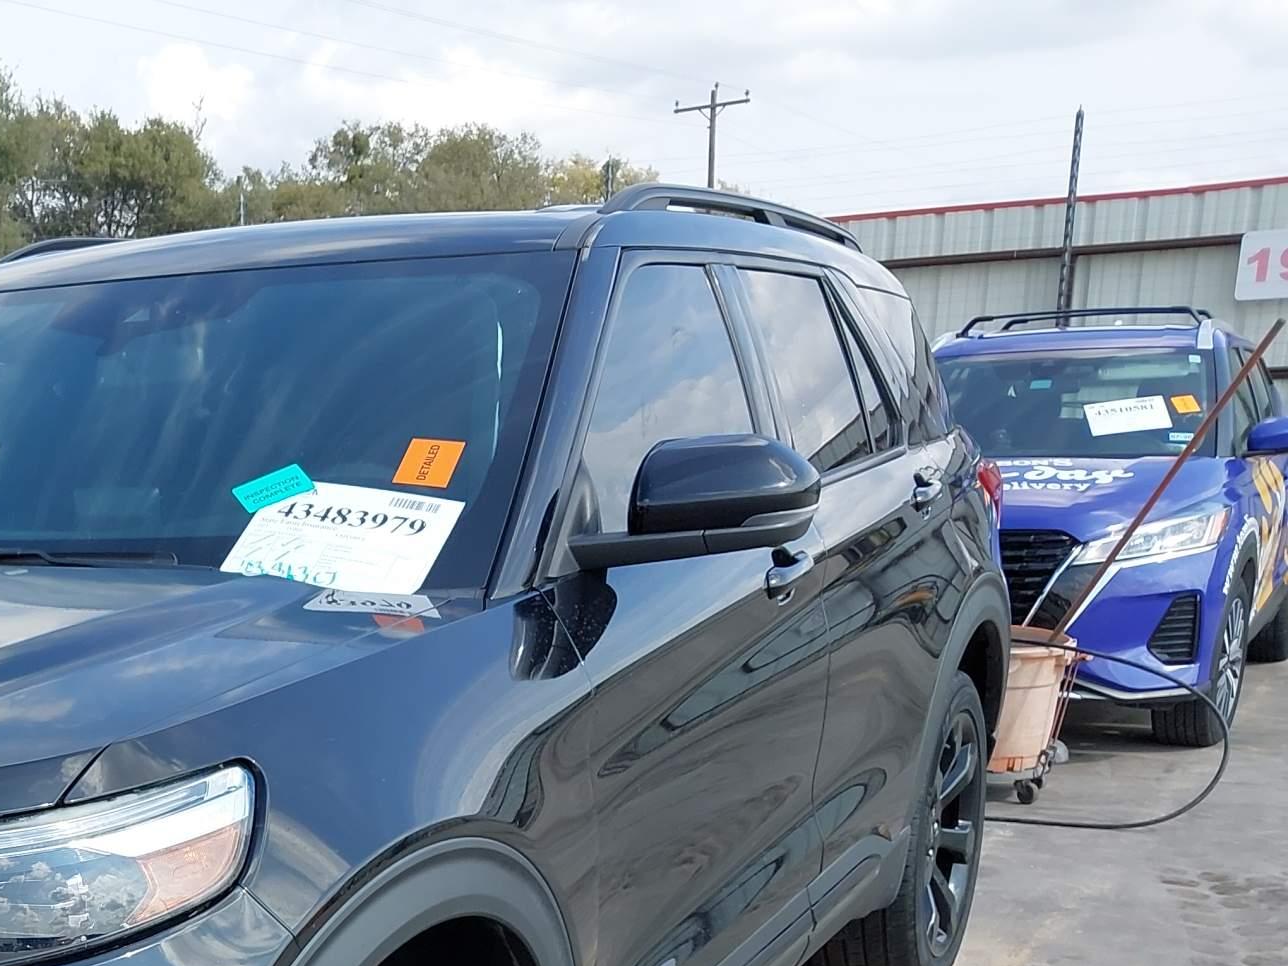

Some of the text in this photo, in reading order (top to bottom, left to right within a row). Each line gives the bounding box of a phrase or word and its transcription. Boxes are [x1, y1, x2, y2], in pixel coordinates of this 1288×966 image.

[416, 445, 441, 481] DETAILED
[244, 474, 301, 501] INSPECTION
[252, 481, 302, 505] COMPLETE
[277, 501, 427, 537] 43483979
